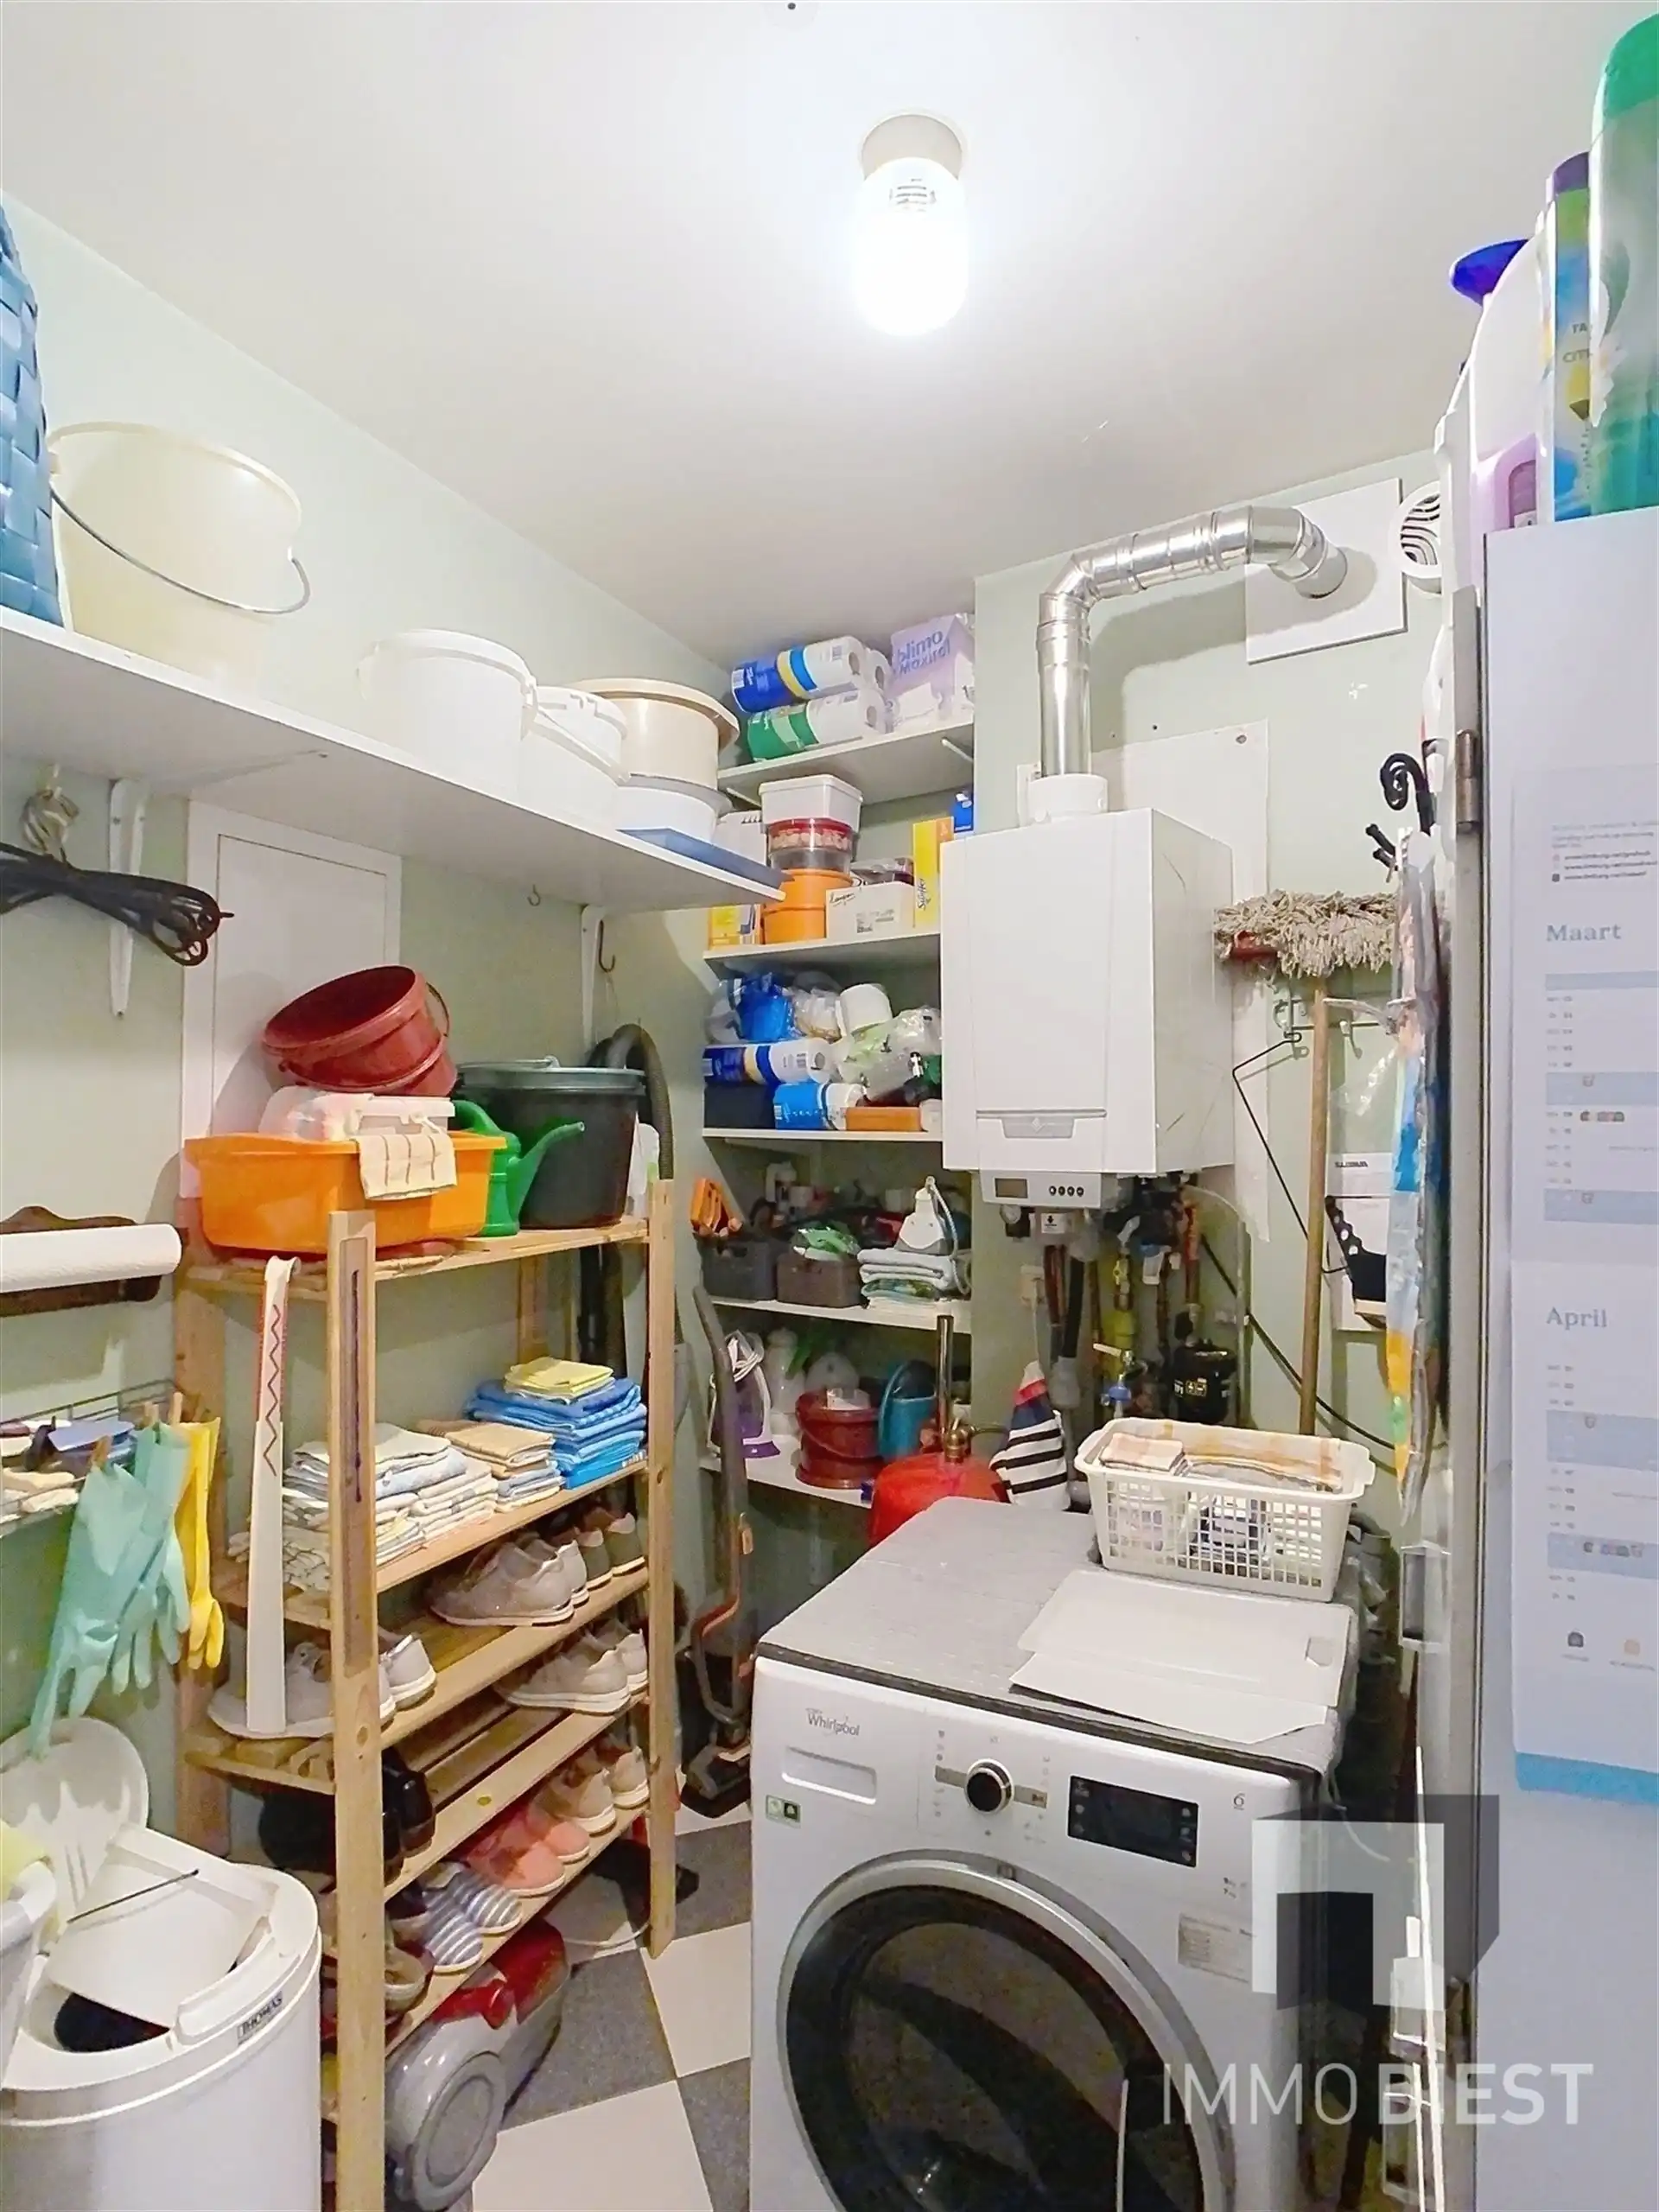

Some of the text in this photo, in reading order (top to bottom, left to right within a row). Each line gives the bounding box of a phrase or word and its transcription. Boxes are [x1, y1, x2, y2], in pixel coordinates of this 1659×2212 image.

[1547, 924, 1621, 941] Maart
[1546, 1306, 1608, 1331] April
[807, 1713, 860, 1736] Whirlpool
